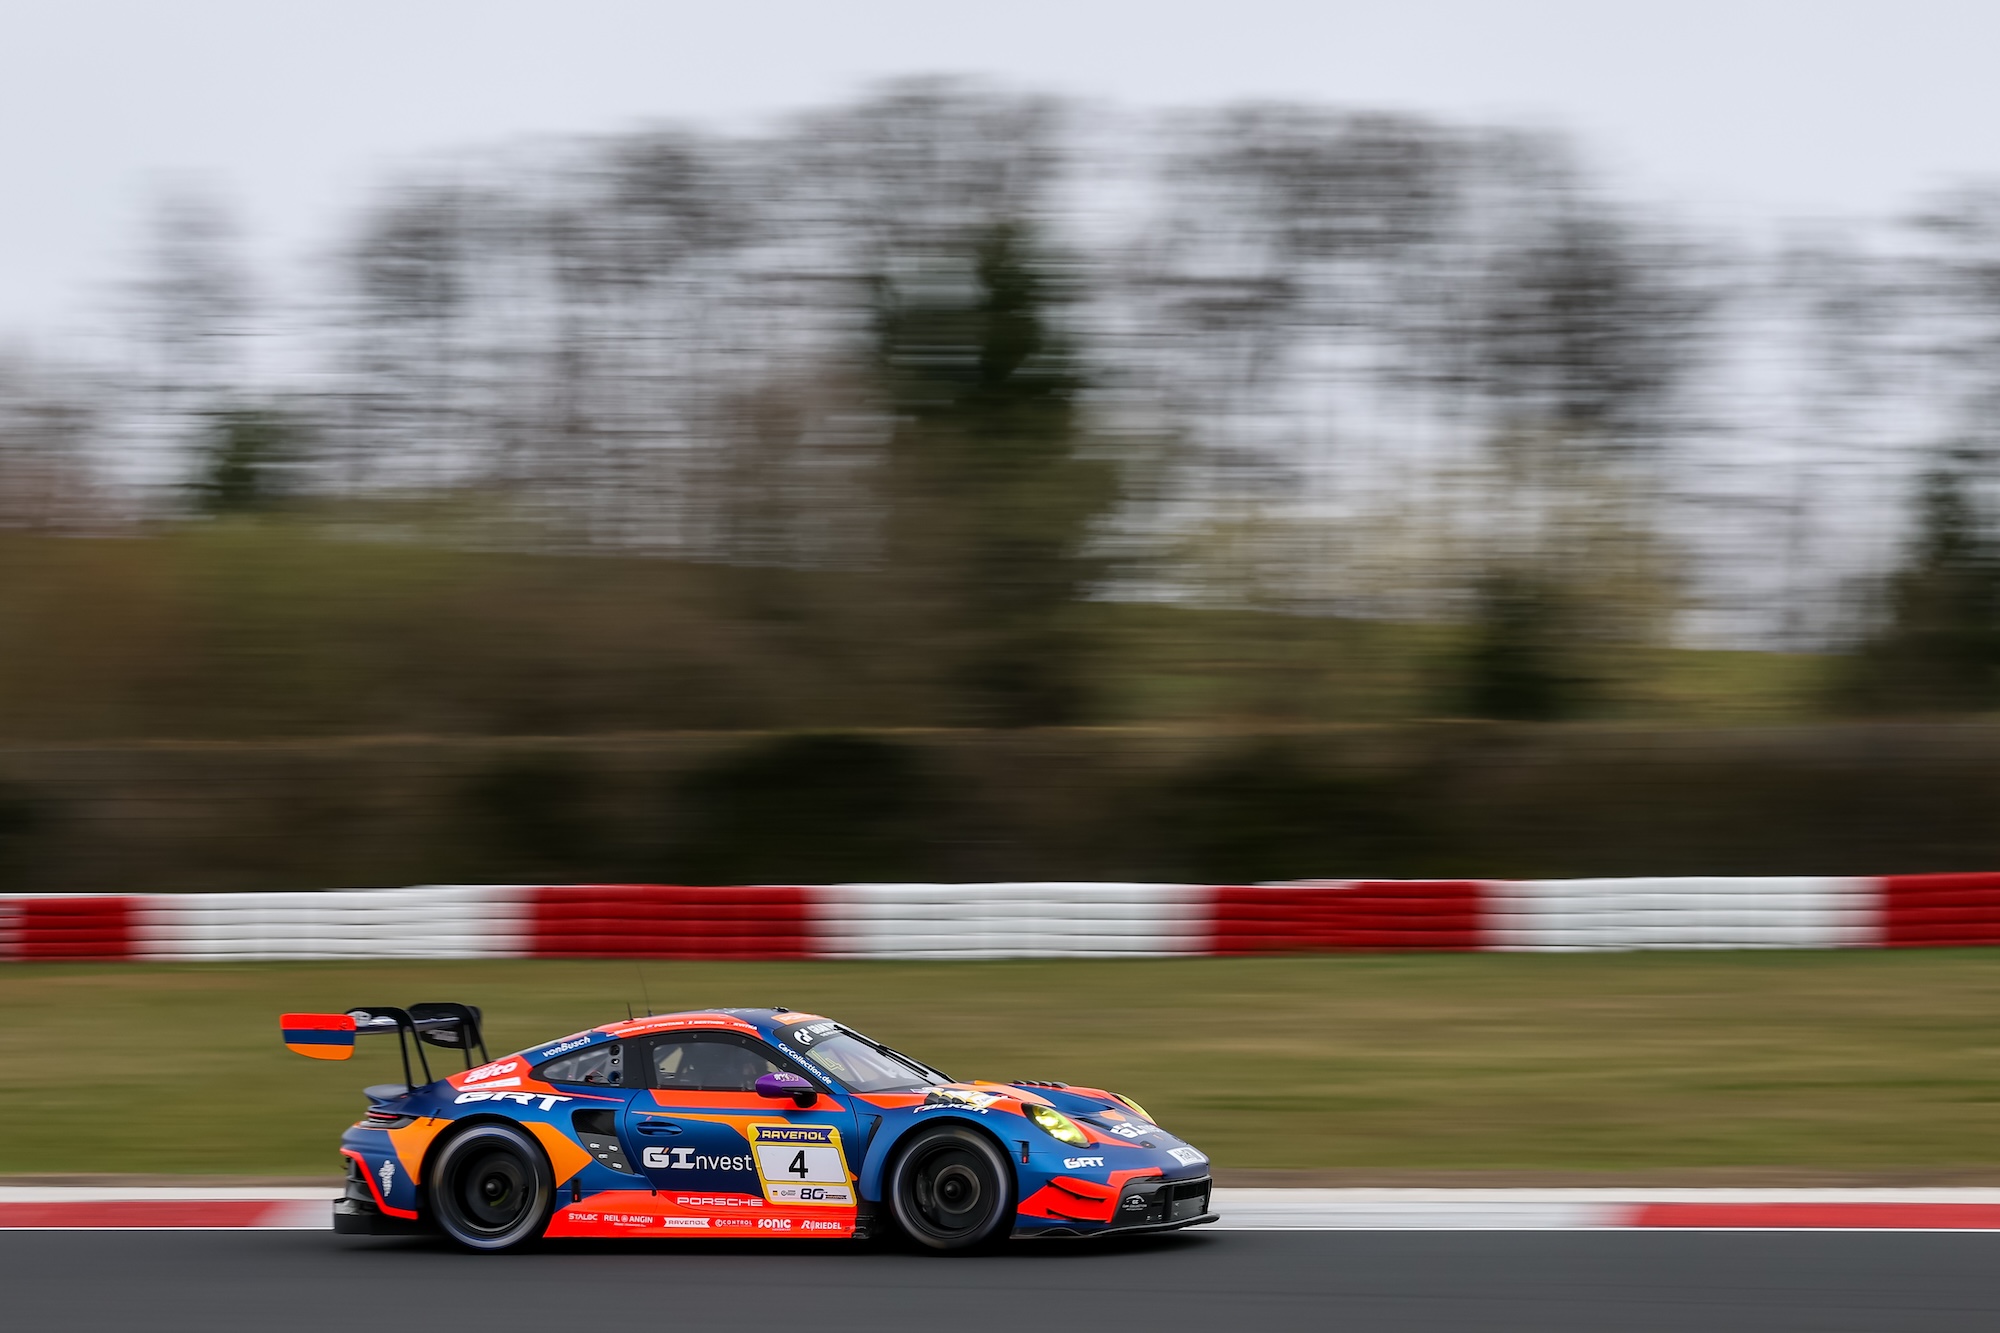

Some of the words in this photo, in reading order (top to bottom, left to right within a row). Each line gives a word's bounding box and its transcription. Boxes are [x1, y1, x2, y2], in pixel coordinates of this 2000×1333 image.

[543, 1036, 591, 1058] vonBusch
[778, 1042, 832, 1085] CarCollection.de
[454, 1091, 573, 1112] GRT
[762, 1129, 826, 1141] RAVENOL
[788, 1150, 808, 1178] 4
[1063, 1156, 1104, 1169] GRT
[677, 1196, 764, 1206] PORSCHE
[568, 1212, 598, 1220] STALOC
[628, 1216, 653, 1224] ANGIN
